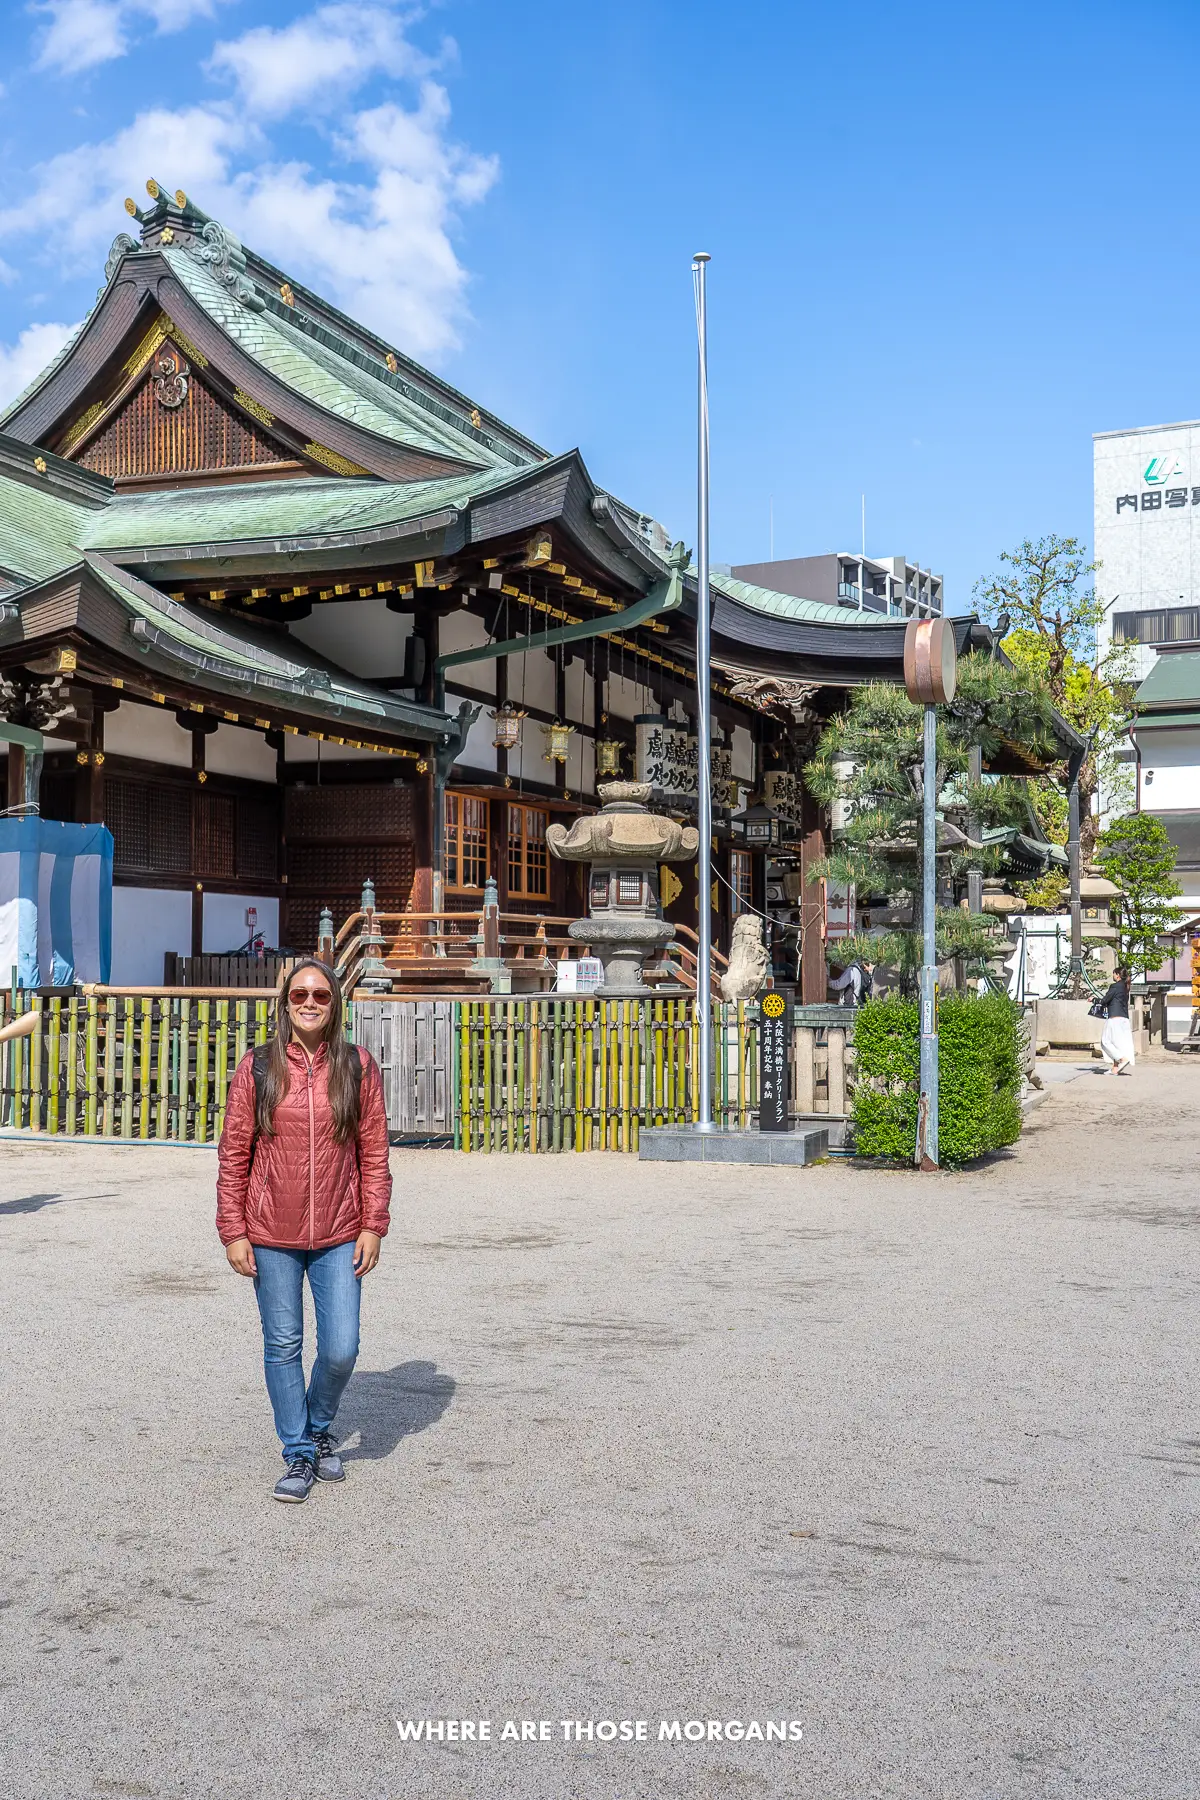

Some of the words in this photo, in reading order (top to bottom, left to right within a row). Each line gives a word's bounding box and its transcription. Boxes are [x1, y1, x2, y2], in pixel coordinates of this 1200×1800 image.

[763, 1019, 773, 1073] 五十周年記念
[775, 1019, 784, 1123] 大阪天満橋ロータリークラブ
[763, 1081, 773, 1099] 奉納
